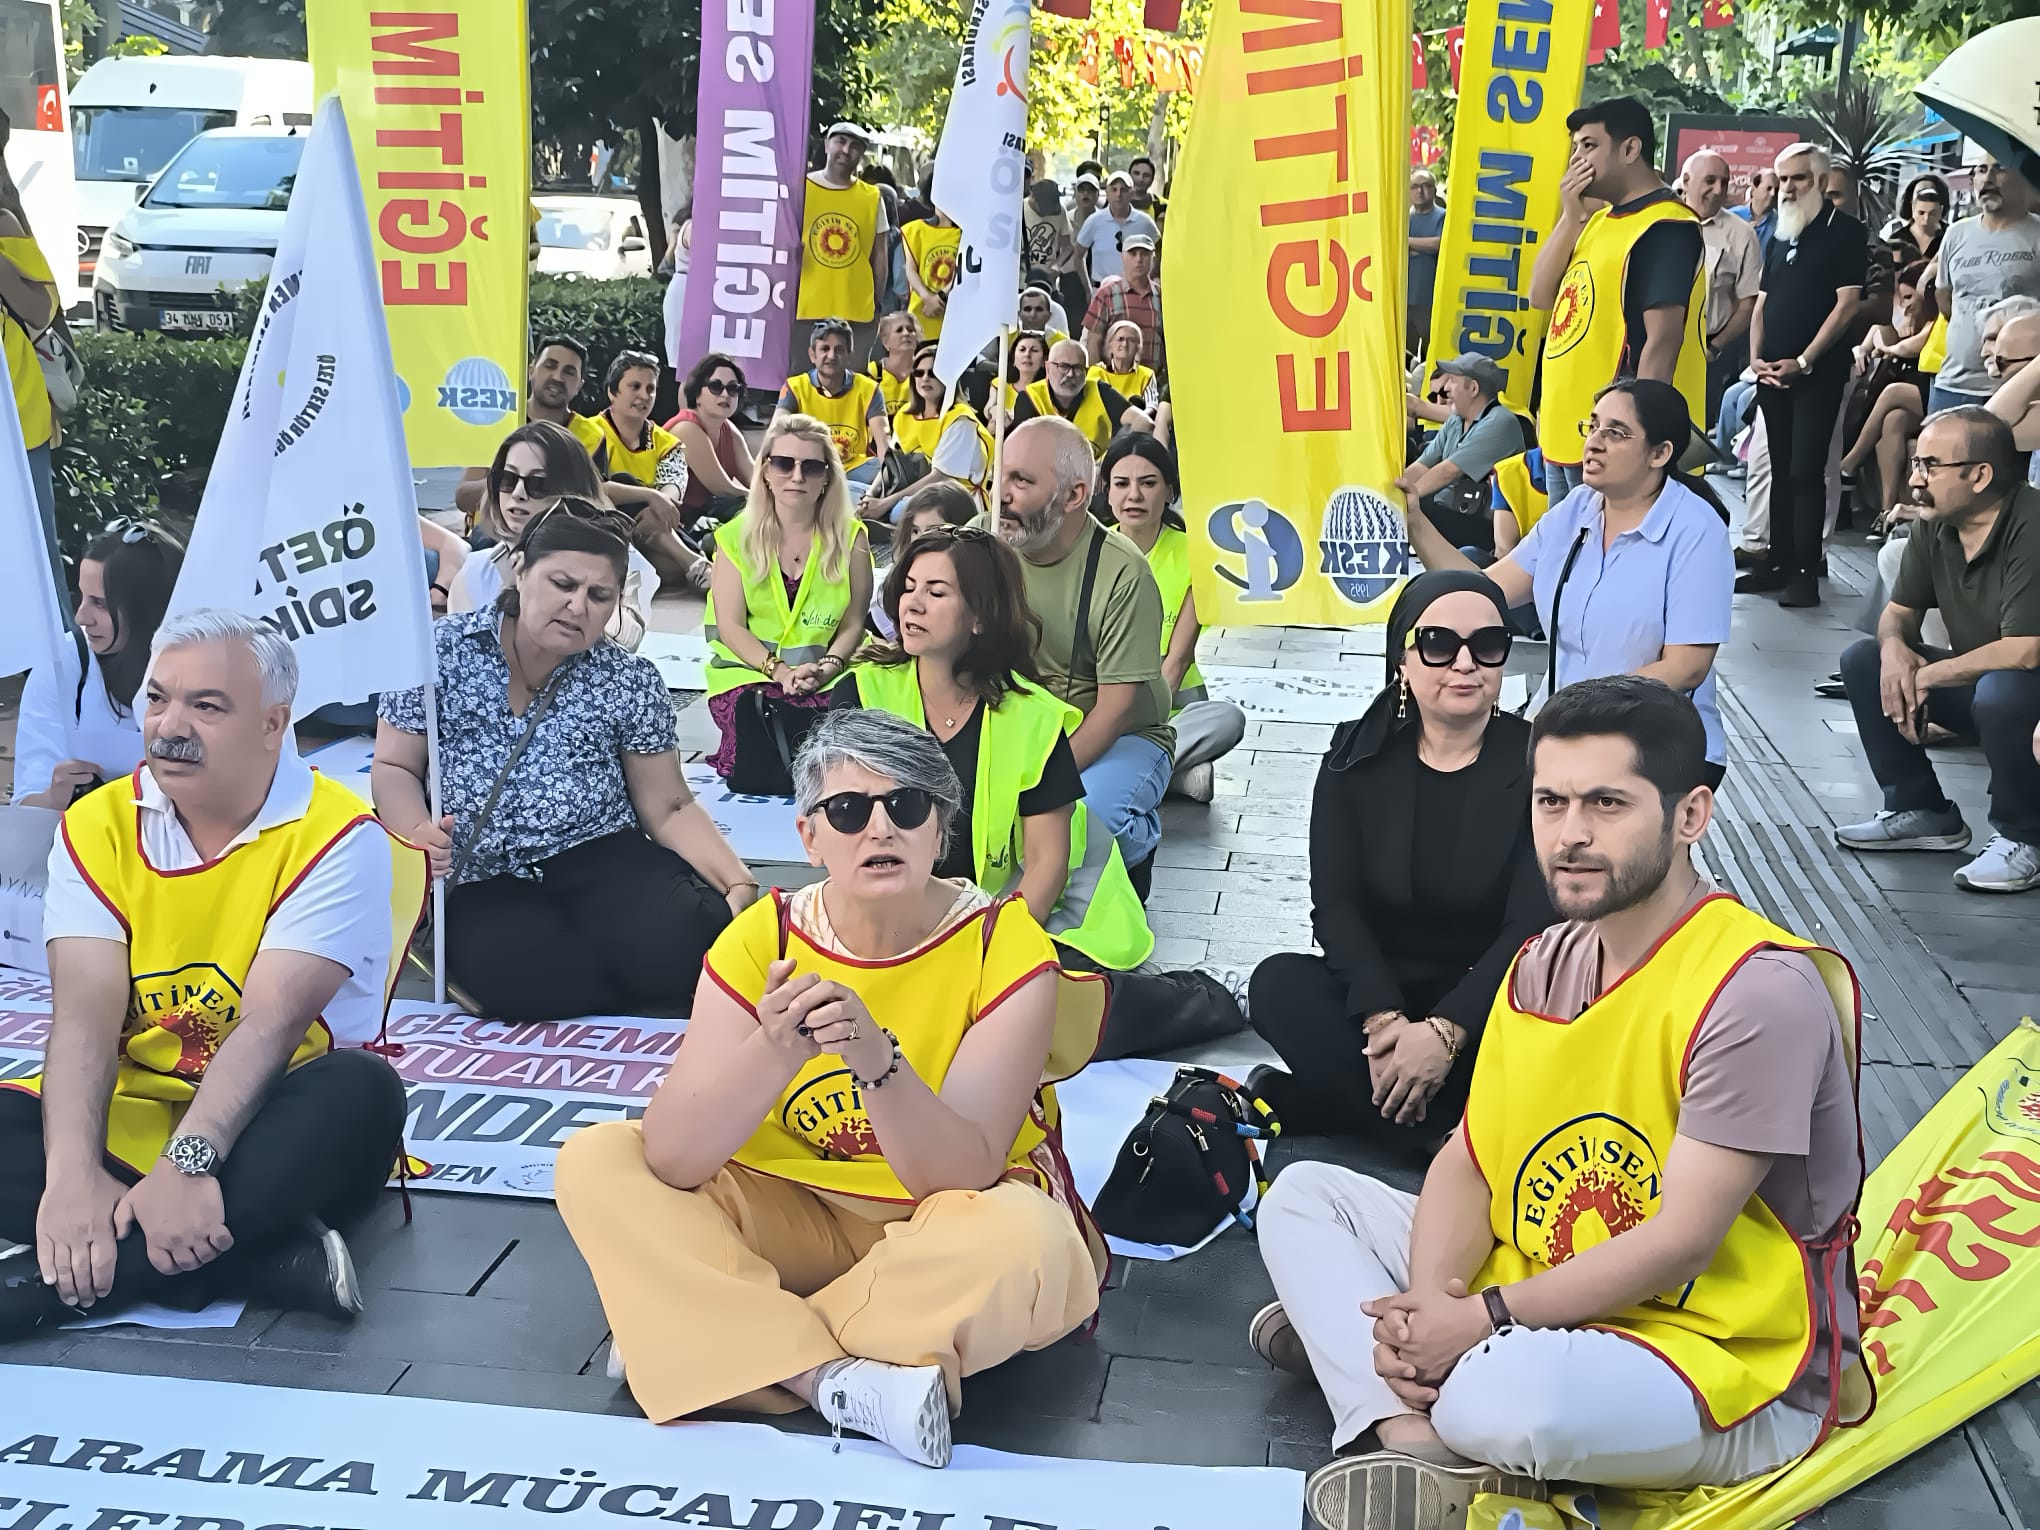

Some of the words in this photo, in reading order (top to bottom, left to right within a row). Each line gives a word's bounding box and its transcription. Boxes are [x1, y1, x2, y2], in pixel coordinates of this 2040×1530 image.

[184, 255, 213, 275] FIAT
[1524, 1136, 1596, 1228] EĞİTİ
[0, 1434, 378, 1496] ARAMA
